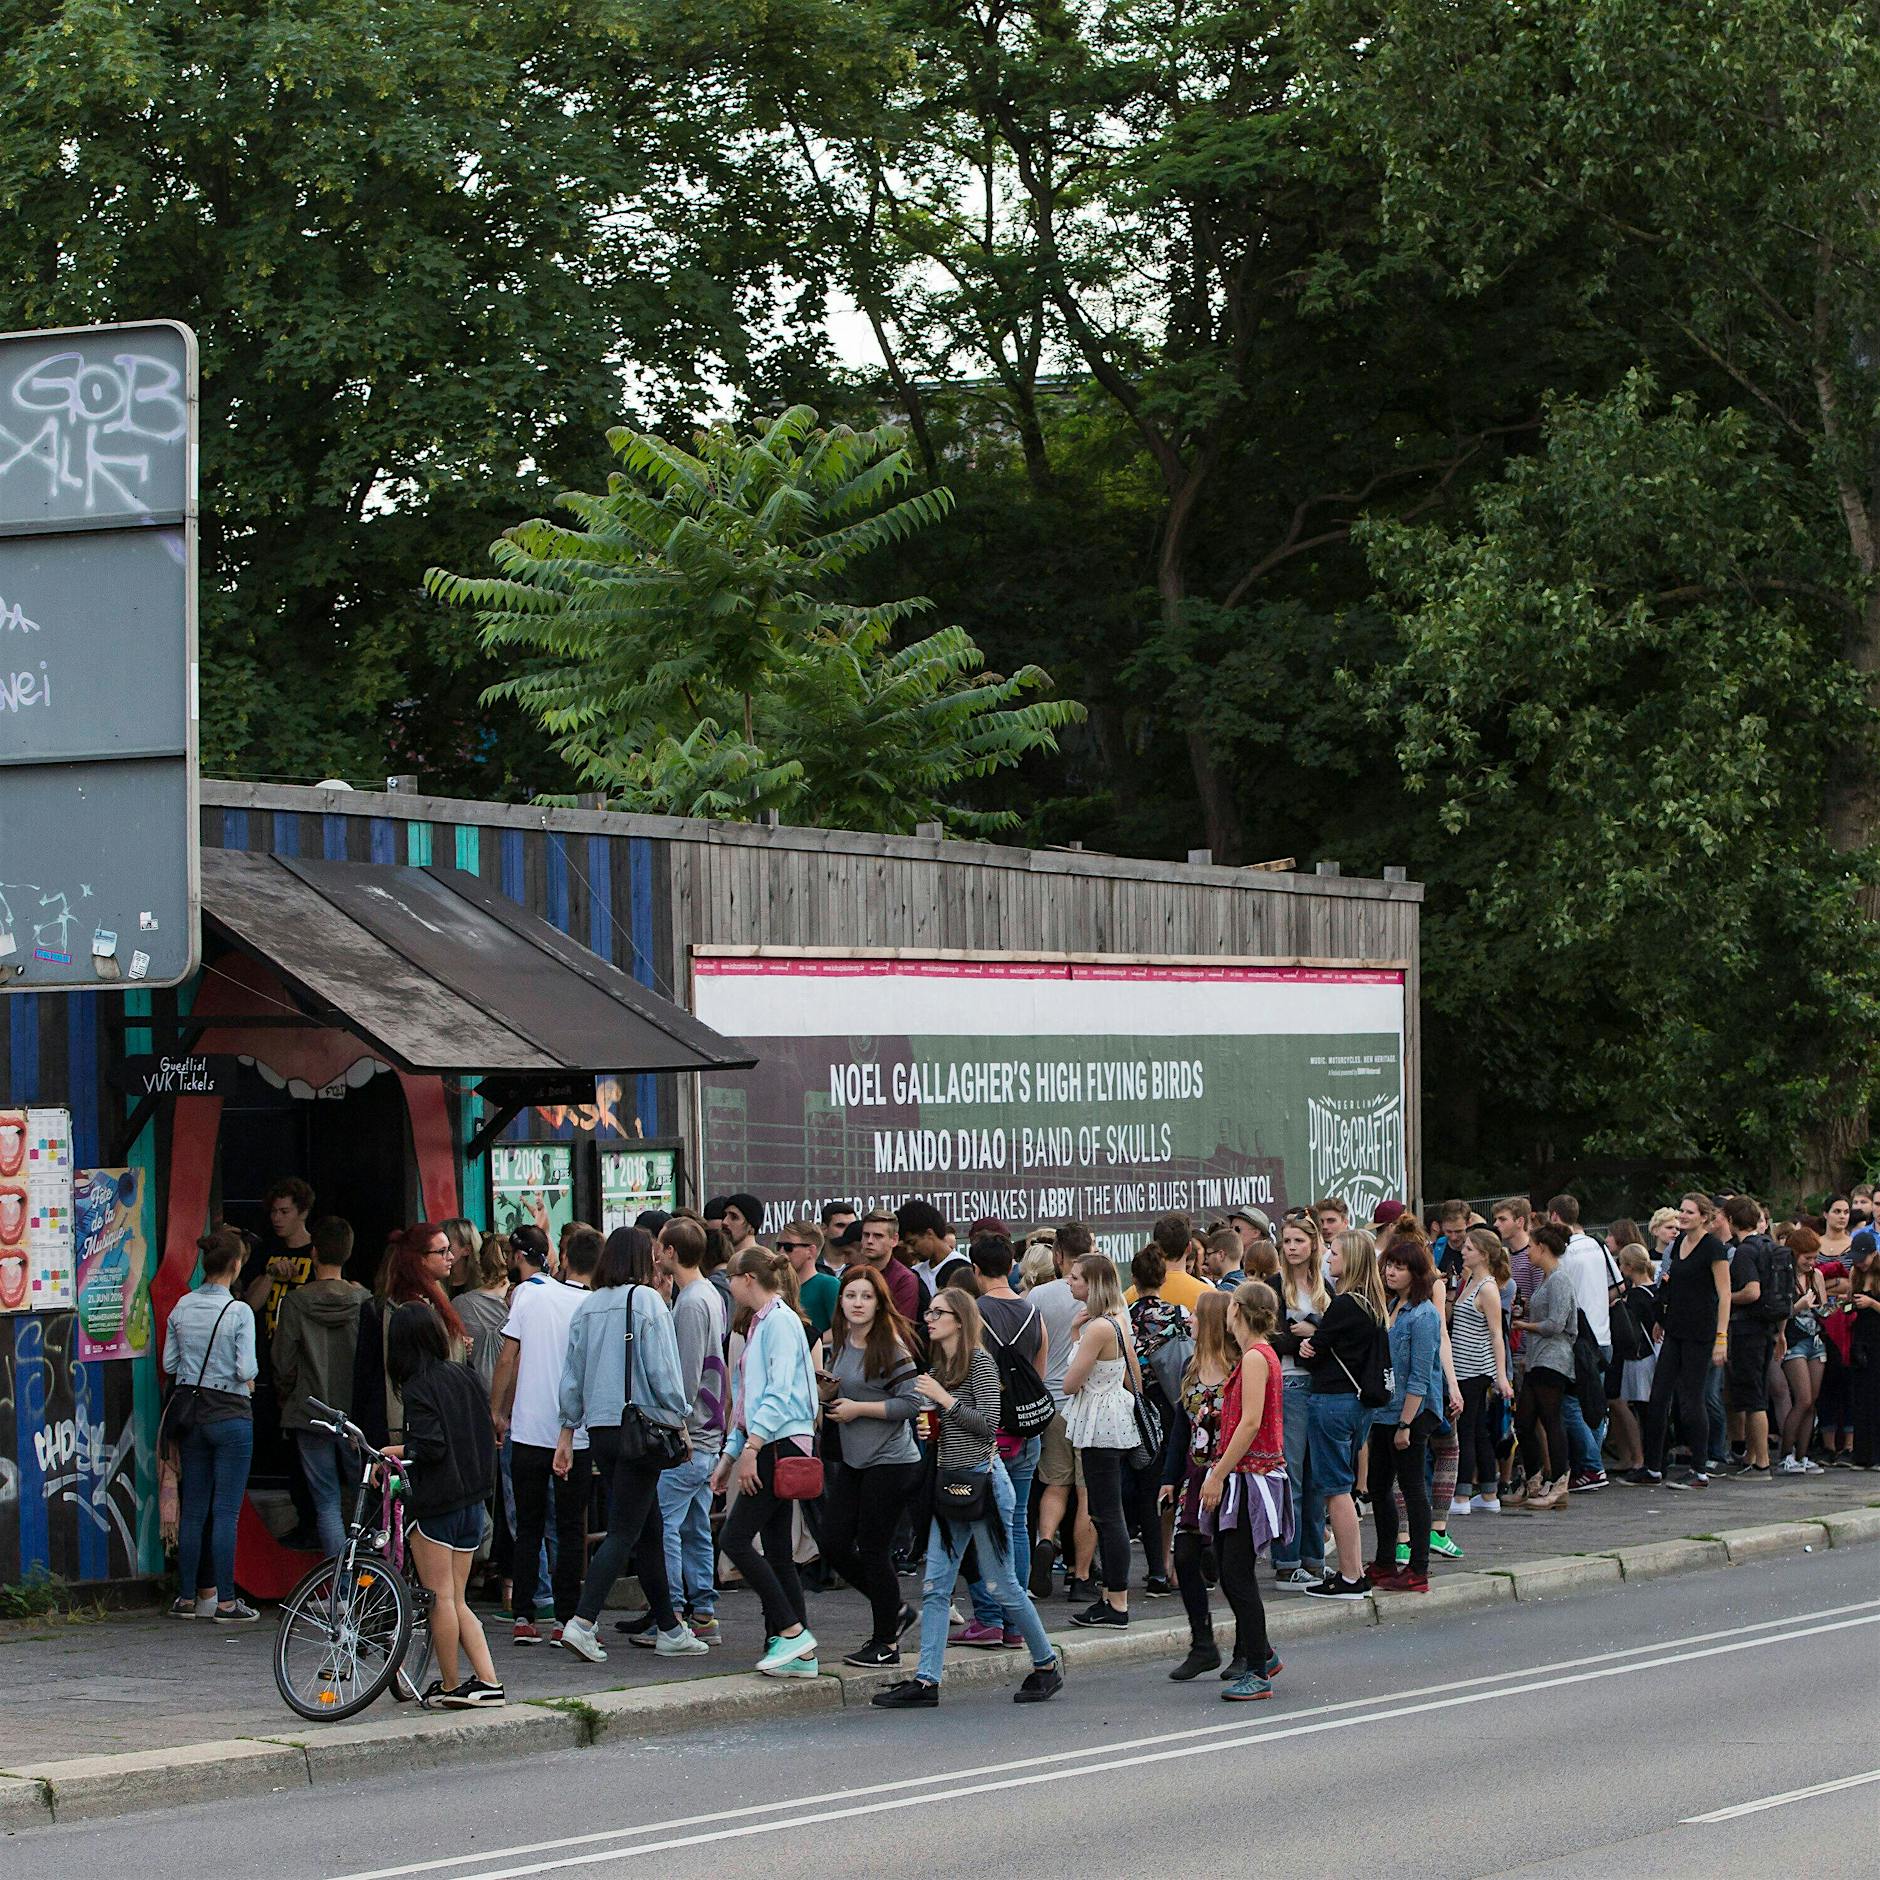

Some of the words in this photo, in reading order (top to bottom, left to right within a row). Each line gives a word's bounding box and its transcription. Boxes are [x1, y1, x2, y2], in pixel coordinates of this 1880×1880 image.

[178, 1071, 215, 1091] Tickets
[830, 1063, 887, 1107] NOEL
[892, 1060, 1031, 1105] GALLAGHER'S
[1035, 1062, 1082, 1103] HIGH
[1087, 1061, 1147, 1102] FLYING
[1151, 1060, 1204, 1100] BIRDS
[1337, 1099, 1373, 1110] BERLIN
[514, 1148, 543, 1180] 2016
[874, 1128, 951, 1174] MANDO
[957, 1127, 1007, 1170] DIAO
[1022, 1126, 1073, 1168] BAND
[1079, 1125, 1101, 1167] OF
[1106, 1122, 1172, 1165] SKULLS
[619, 1156, 647, 1188] 2016
[758, 1200, 798, 1234] ANK
[1038, 1188, 1074, 1218] ABBY
[1085, 1185, 1112, 1216] THE
[1114, 1183, 1146, 1214] KING
[1148, 1180, 1188, 1212] BLUES
[1197, 1178, 1222, 1209] TIM
[1223, 1176, 1275, 1207] VANTOL
[1095, 1232, 1134, 1263] ERKIN
